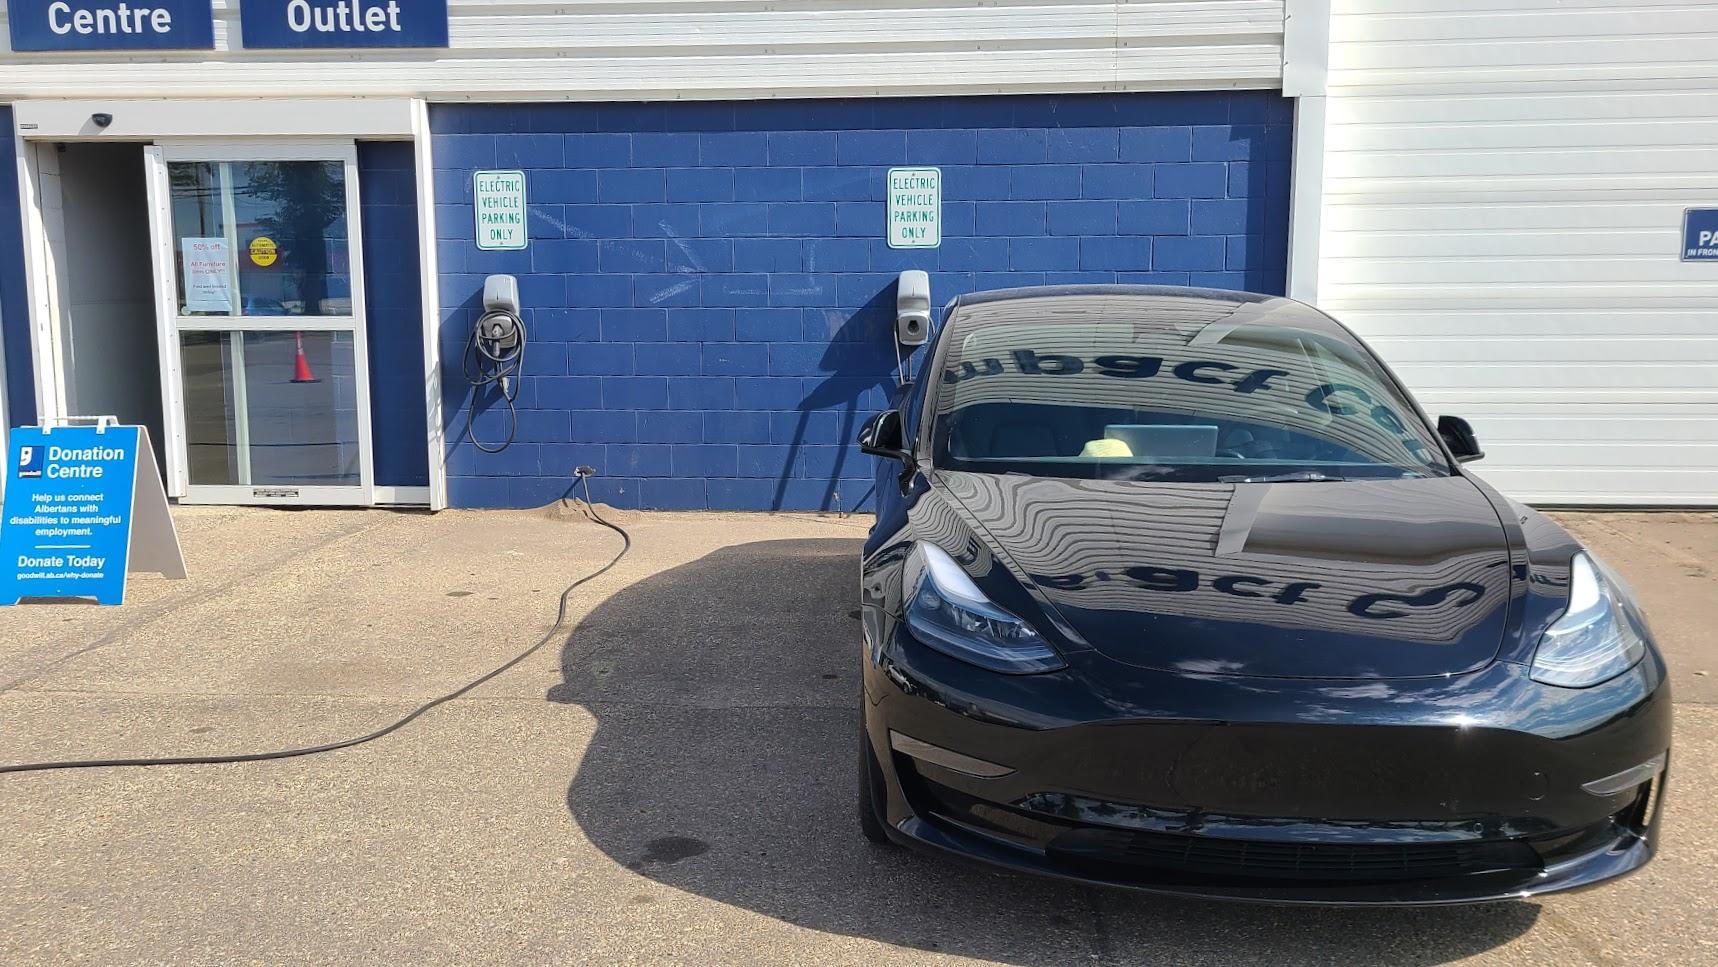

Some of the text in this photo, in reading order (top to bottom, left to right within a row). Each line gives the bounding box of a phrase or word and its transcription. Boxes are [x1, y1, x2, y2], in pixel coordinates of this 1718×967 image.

[48, 1, 172, 35] Centre
[287, 0, 402, 32] Outlet
[480, 181, 520, 192] ELECTRIC
[893, 178, 935, 189] ELECTRIC
[482, 197, 519, 208] VEHICLE
[895, 194, 933, 206] VEHICLE
[482, 213, 520, 224] PARKING
[894, 211, 934, 222] PARKING
[491, 229, 513, 240] ONLY
[902, 227, 926, 238] ONLY
[1687, 248, 1697, 256] IN
[49, 446, 124, 461] Donation
[47, 464, 103, 478] Centre
[32, 494, 52, 503] Help
[67, 494, 104, 502] connect
[34, 505, 78, 513] Albertans
[9, 516, 58, 525] disabilities
[72, 516, 121, 525] meaningful
[35, 528, 93, 537] employment.
[17, 555, 105, 569] Donate Today
[17, 571, 104, 580] goodwill.ab.ca/why-donate
